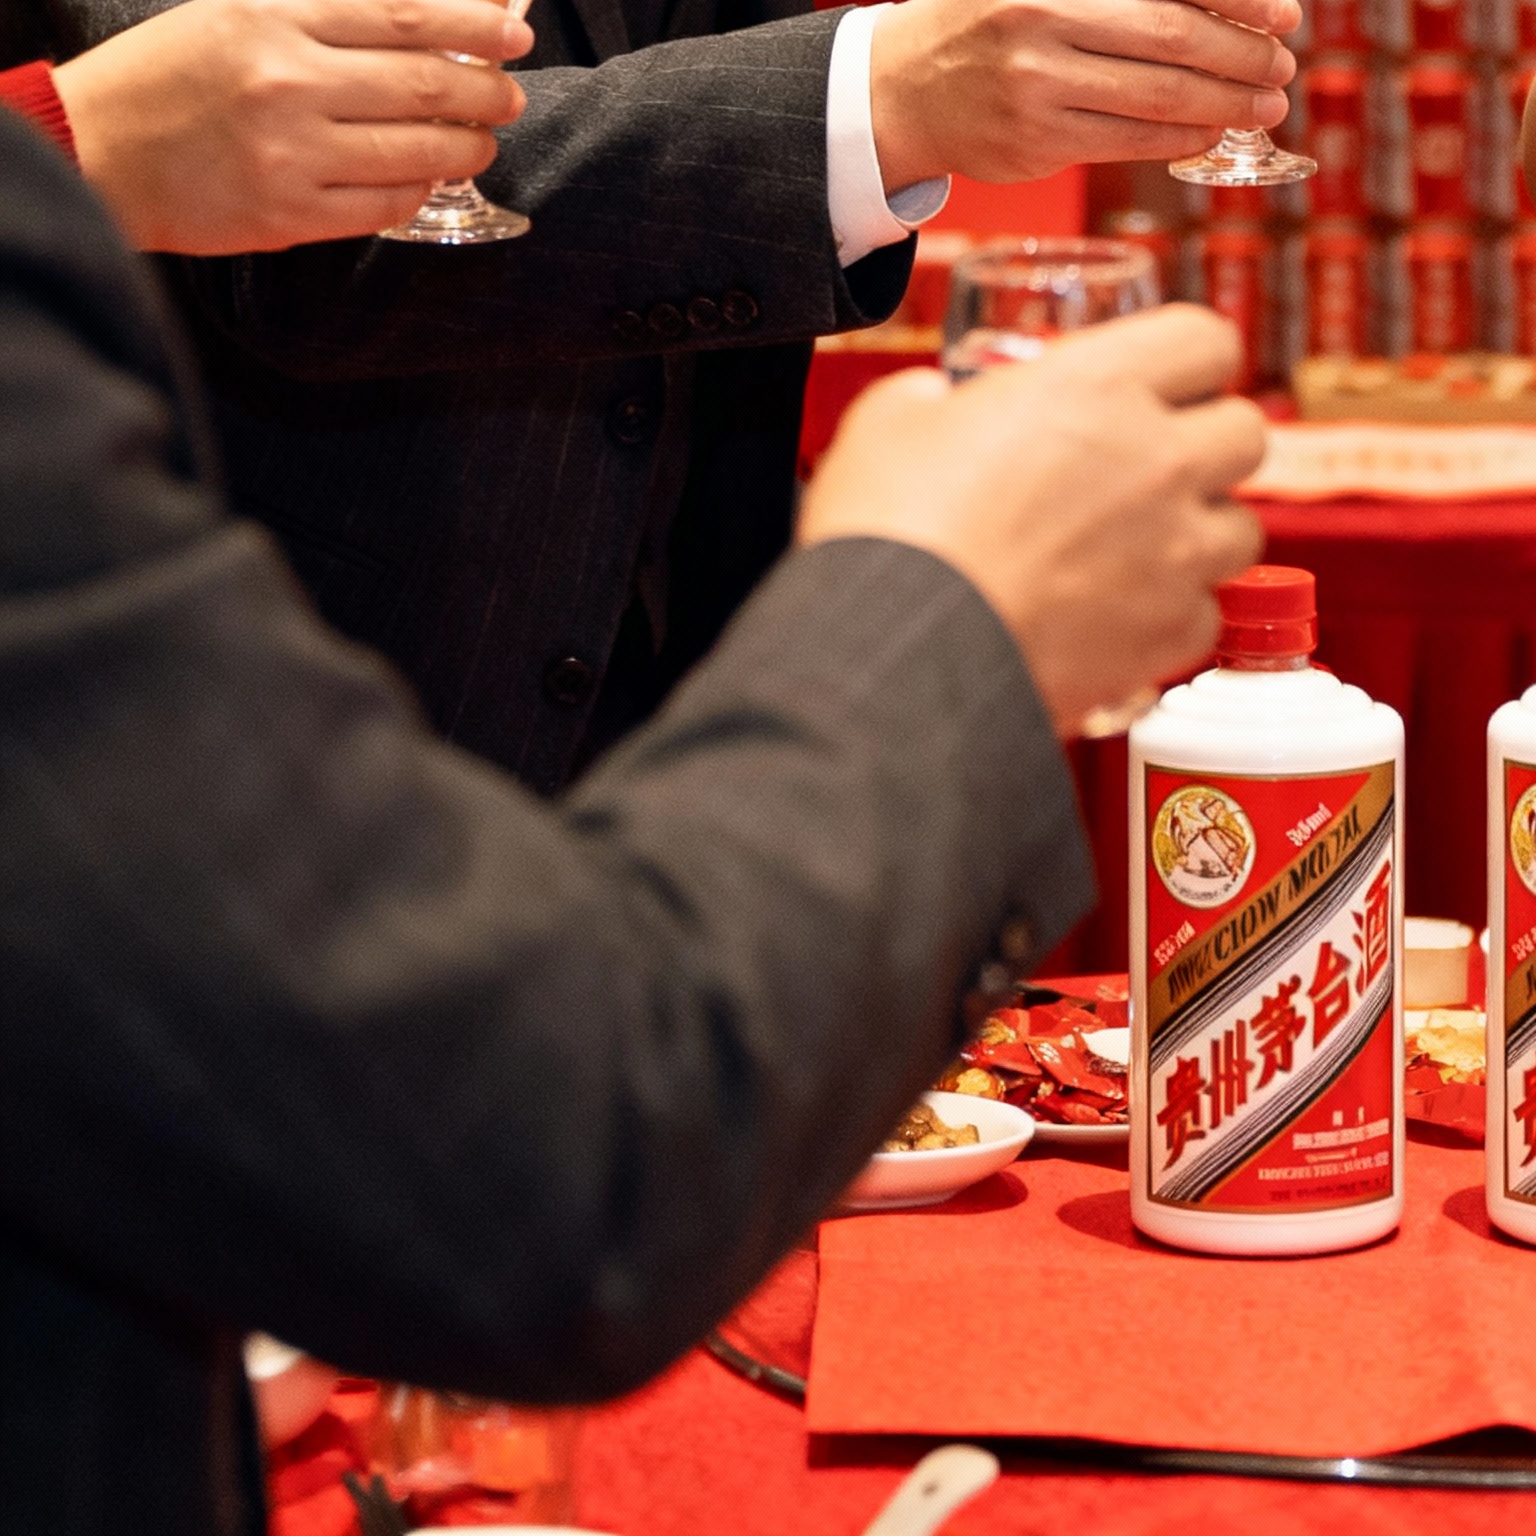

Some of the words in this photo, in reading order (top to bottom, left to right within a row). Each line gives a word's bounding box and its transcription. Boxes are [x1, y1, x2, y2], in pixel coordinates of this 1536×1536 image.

[1156, 860, 1391, 1171] 贵州茅台酒
